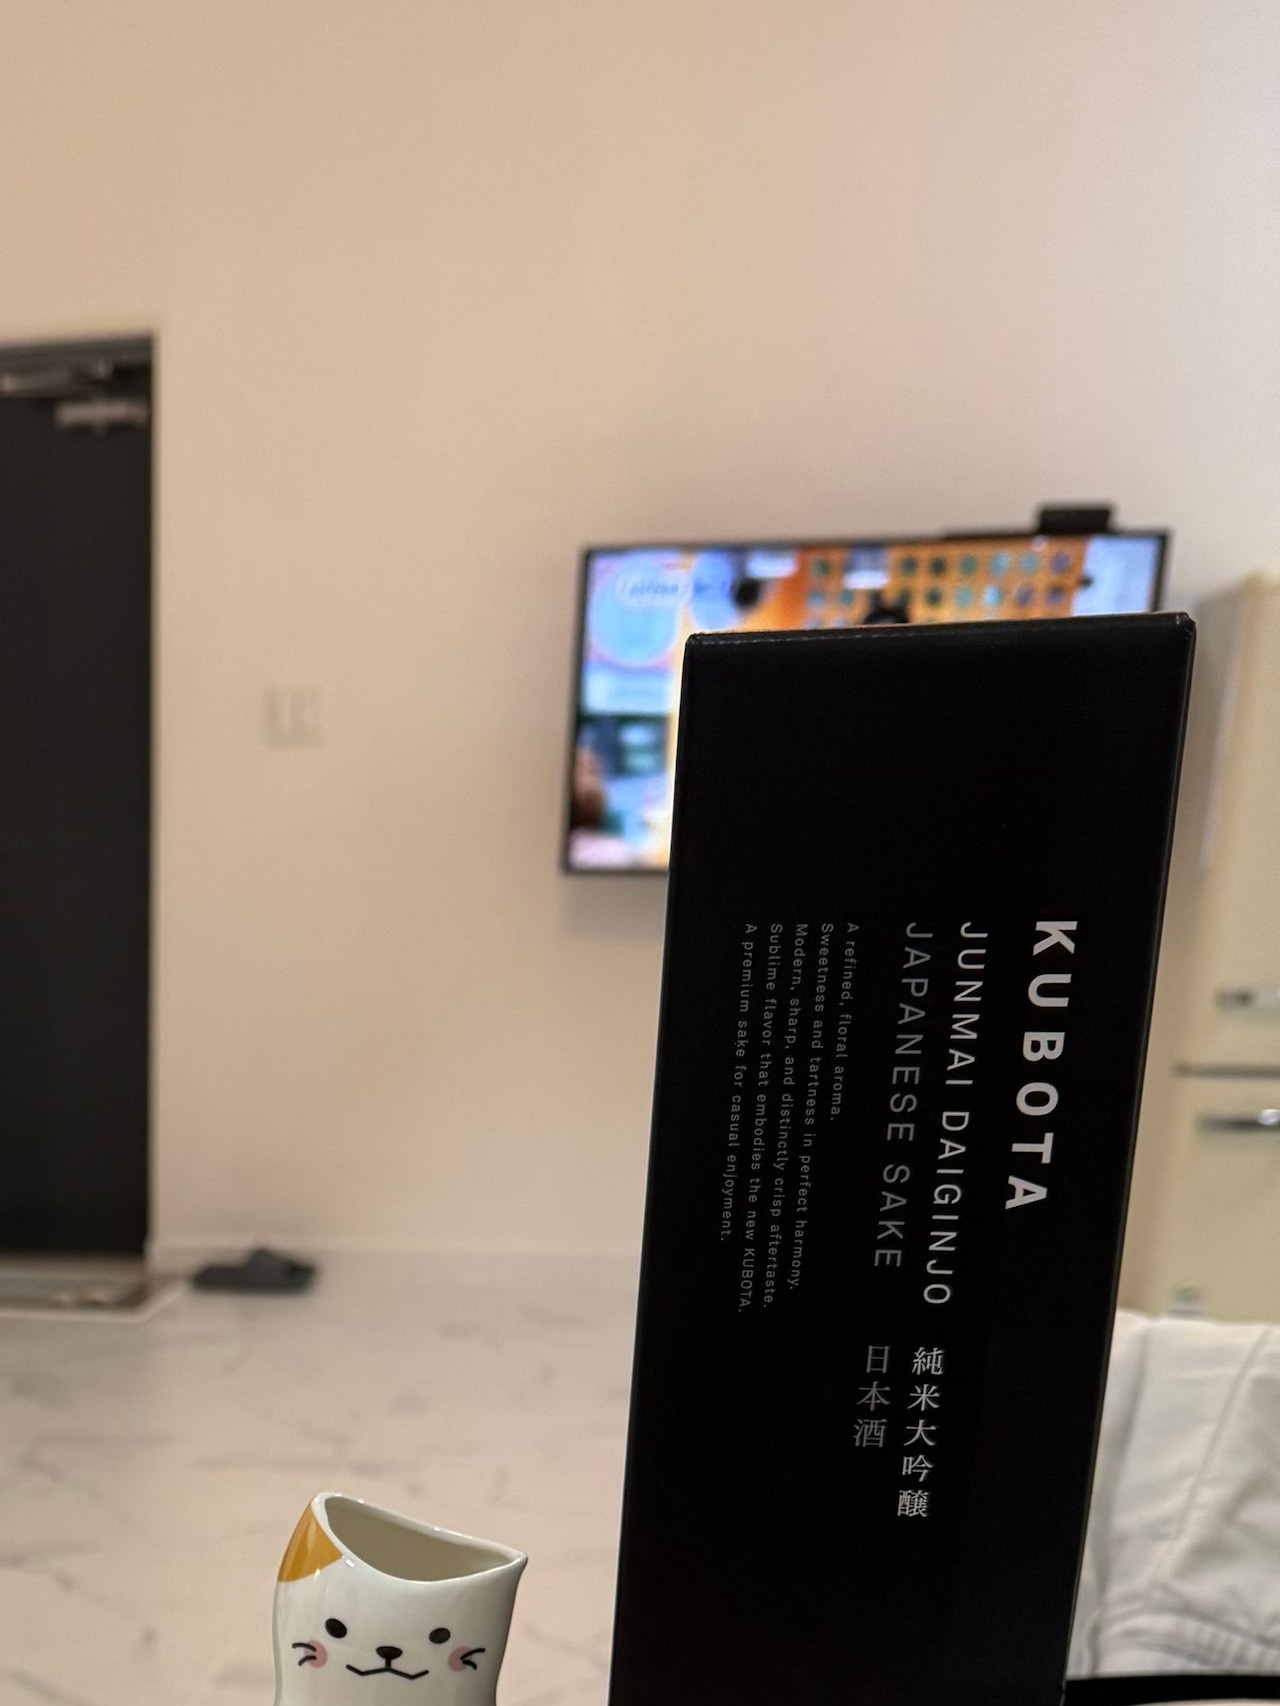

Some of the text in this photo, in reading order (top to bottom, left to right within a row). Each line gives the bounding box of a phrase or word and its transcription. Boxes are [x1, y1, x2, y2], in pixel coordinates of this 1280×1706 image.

[720, 923, 758, 1241] A premium sake for casual enjoyment.
[738, 923, 784, 1313] Sublime flavor that embodies the new KUBOTA.
[763, 923, 809, 1308] Modern, sharp, and distinctly crisp aftertaste.
[786, 922, 835, 1290] Sweetness and tartness in perfect harmony.
[829, 922, 860, 1121] A refined, floral aroma.
[874, 921, 934, 1268] JAPANESE SAKE
[923, 921, 989, 1304] JUNMAI DAIGINJO
[1004, 920, 1078, 1210] KUBOTA
[852, 1345, 891, 1448] 日本酒
[897, 1346, 946, 1518] 純米大吟醸
